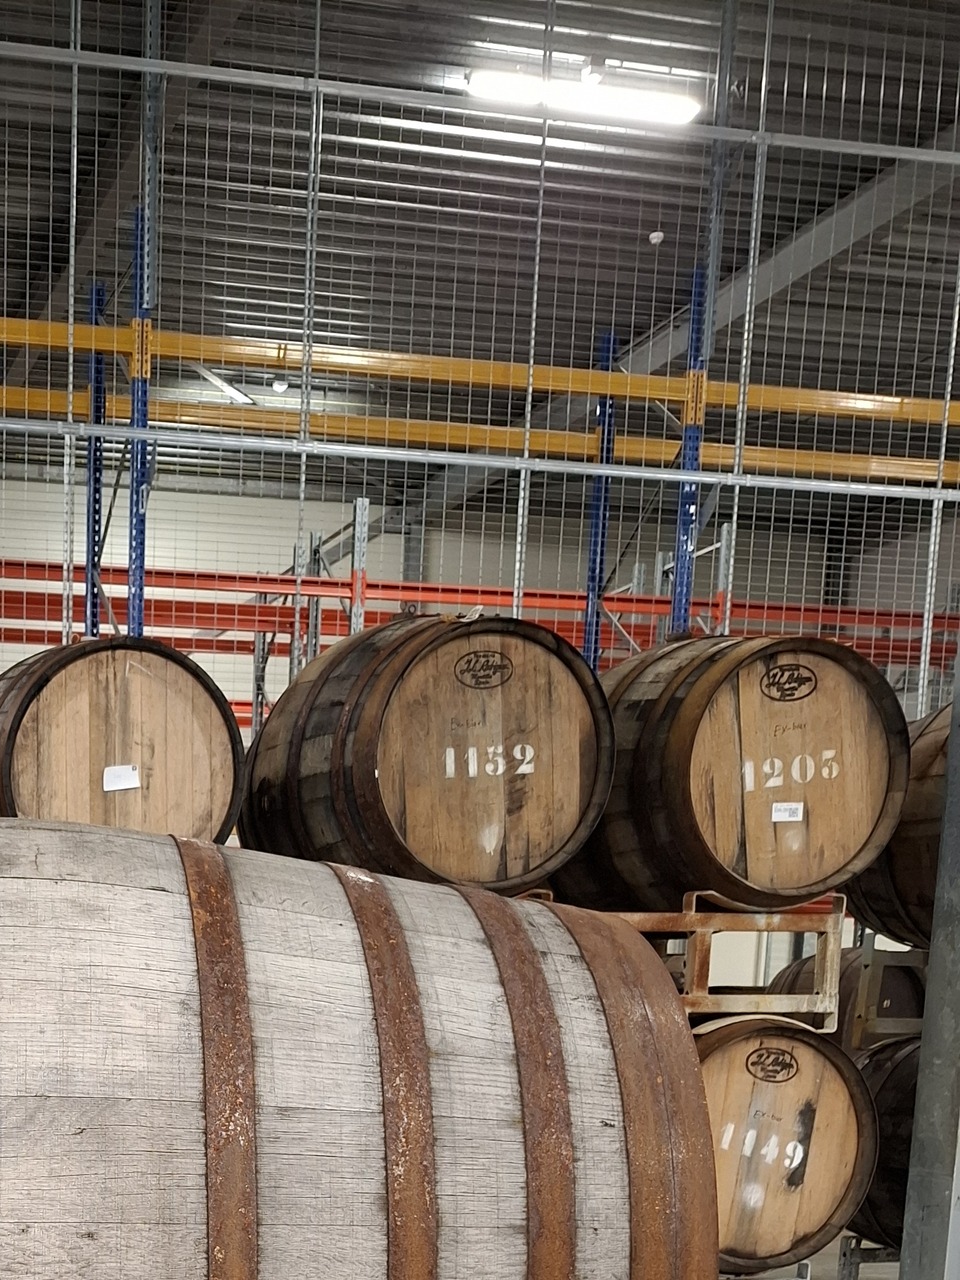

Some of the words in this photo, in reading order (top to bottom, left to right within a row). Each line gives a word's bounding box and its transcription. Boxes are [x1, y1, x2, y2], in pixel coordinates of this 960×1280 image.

[442, 744, 535, 778] 1152
[742, 749, 840, 792] 1205
[720, 1122, 804, 1169] 1149
